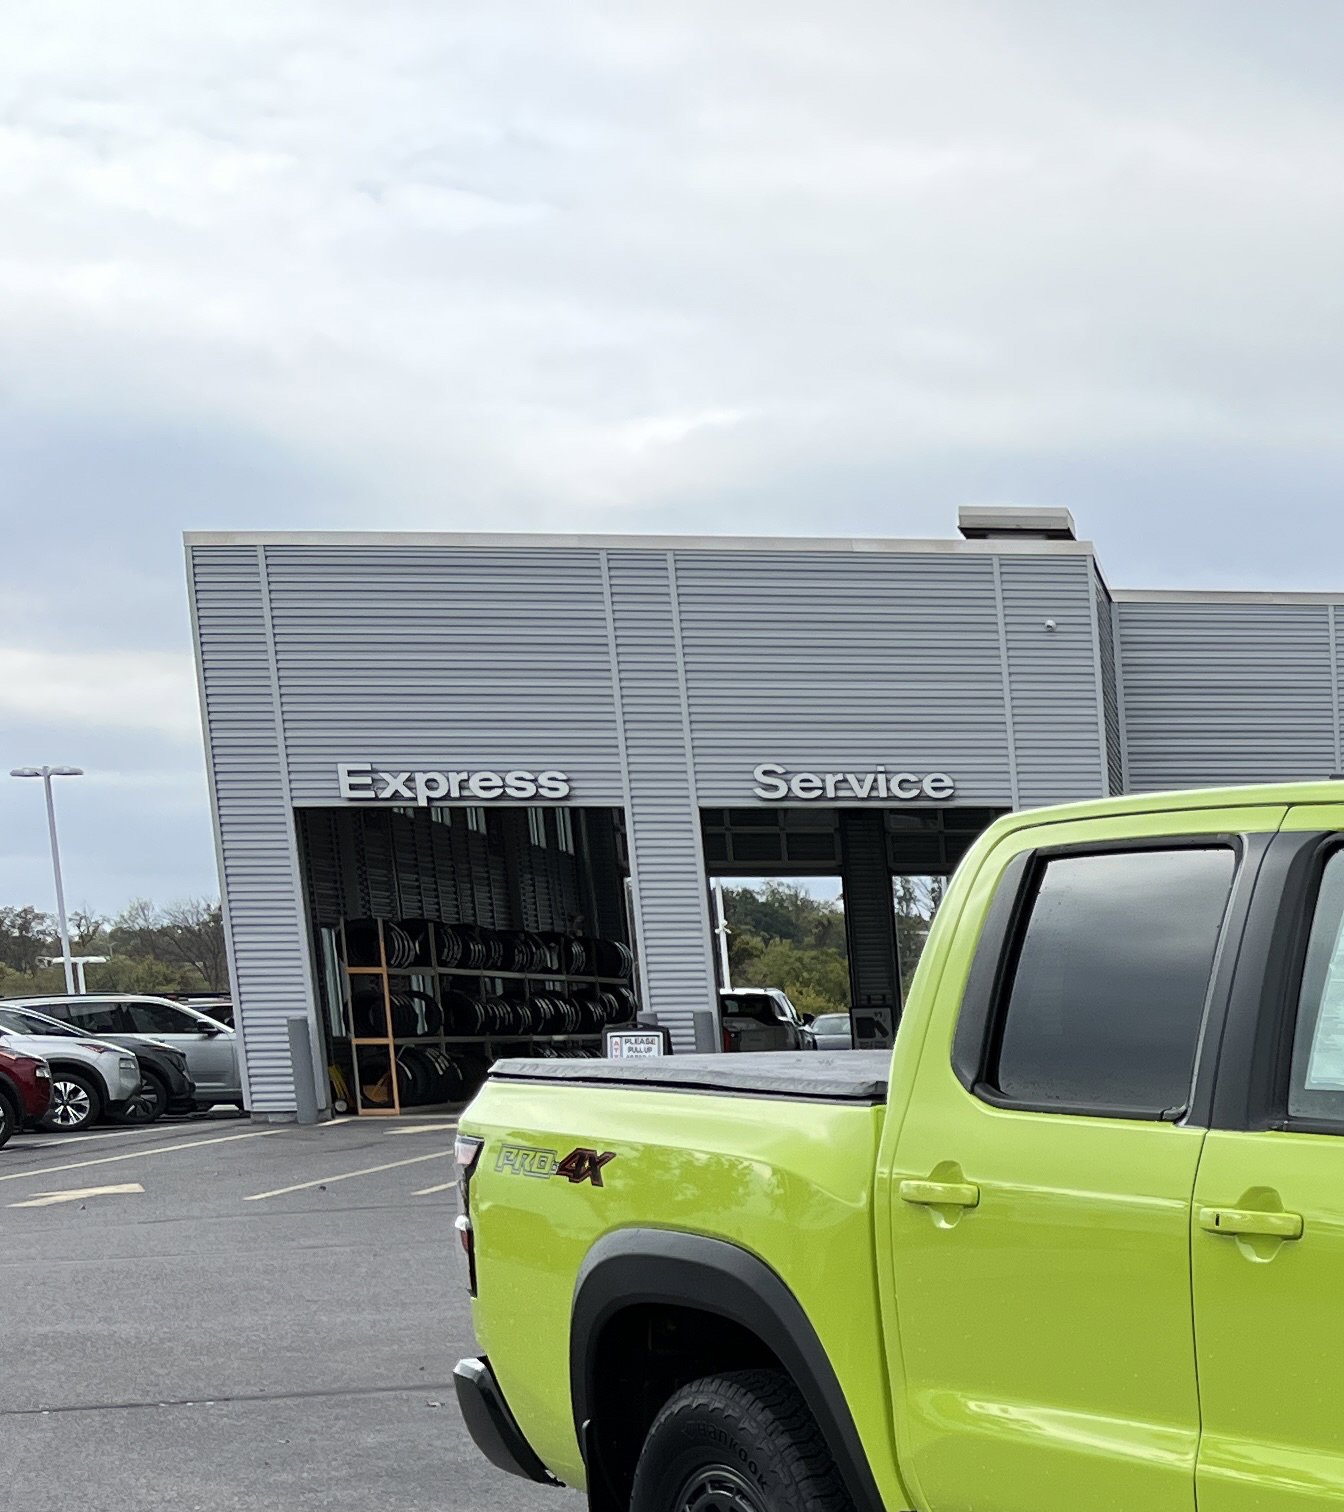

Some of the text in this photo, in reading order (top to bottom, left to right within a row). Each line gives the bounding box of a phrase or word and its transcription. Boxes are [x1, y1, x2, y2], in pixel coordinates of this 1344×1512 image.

[336, 762, 571, 807] Express
[753, 763, 955, 800] Service
[624, 1037, 656, 1046] PLEASE
[627, 1046, 642, 1054] PULL
[644, 1046, 653, 1054] UP
[494, 1143, 617, 1187] PRO-4X
